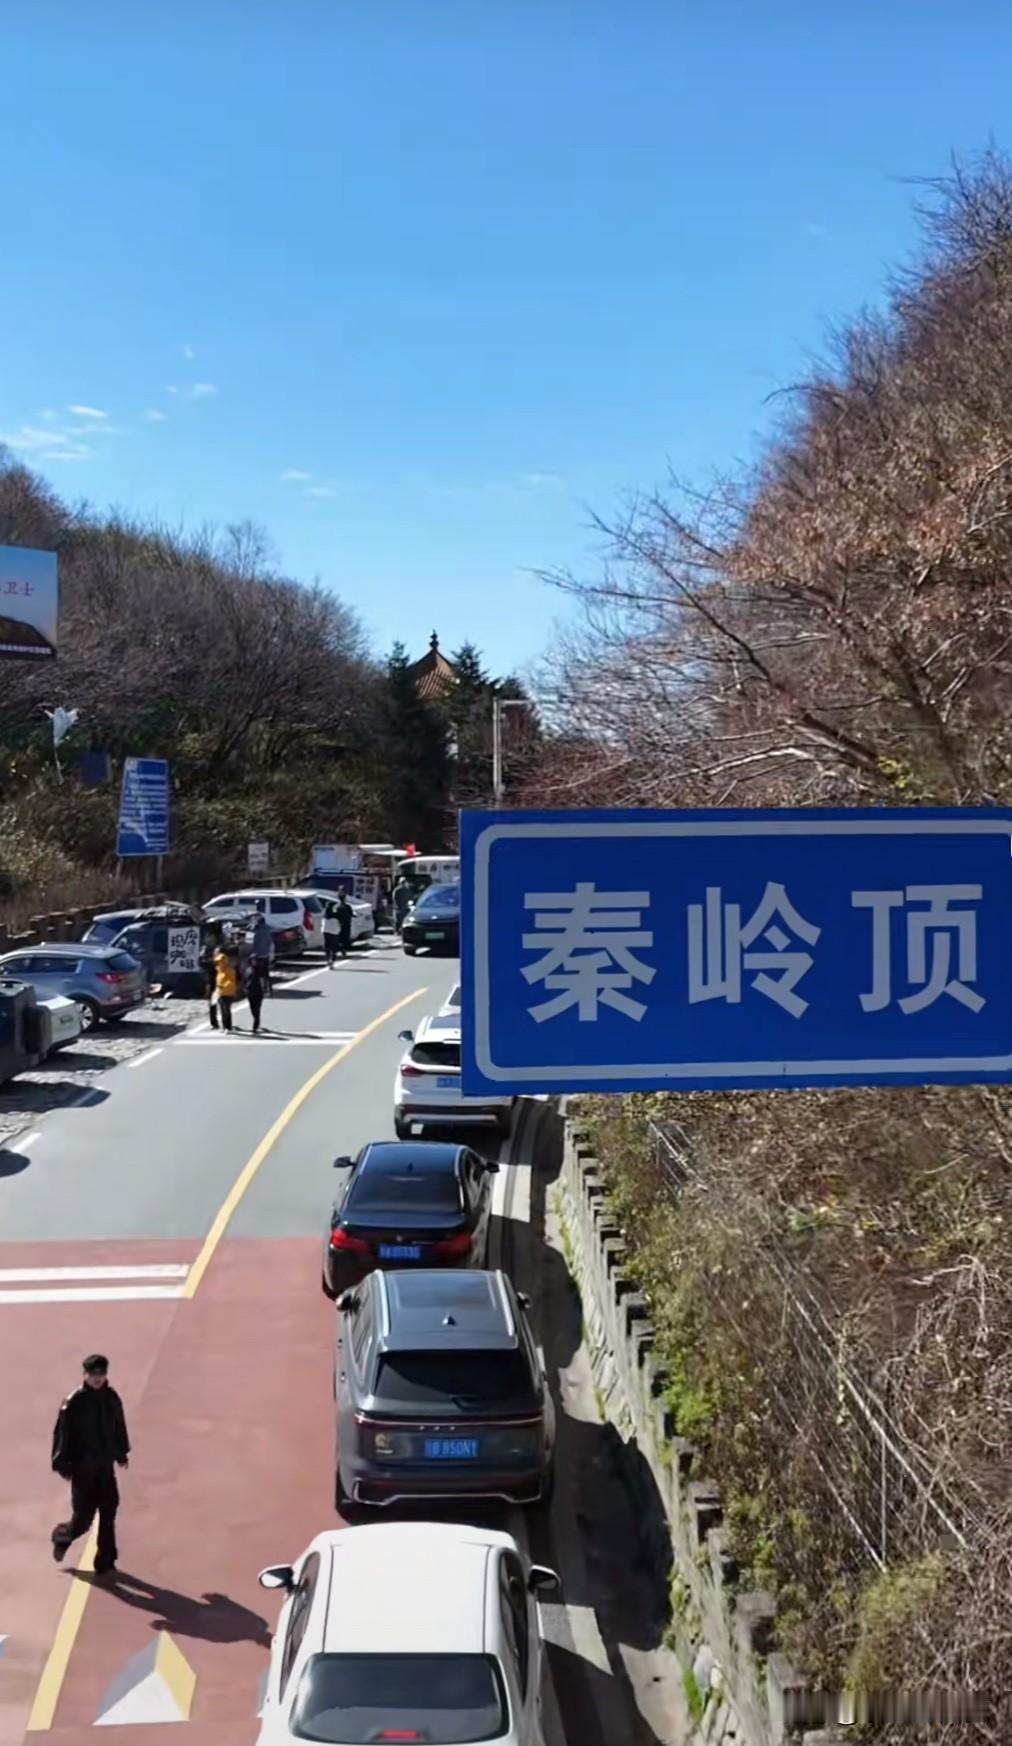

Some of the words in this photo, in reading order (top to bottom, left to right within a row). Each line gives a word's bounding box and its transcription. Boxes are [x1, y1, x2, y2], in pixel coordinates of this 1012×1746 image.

[0, 581, 35, 597] 卫士
[519, 881, 986, 1023] 秦岭顶
